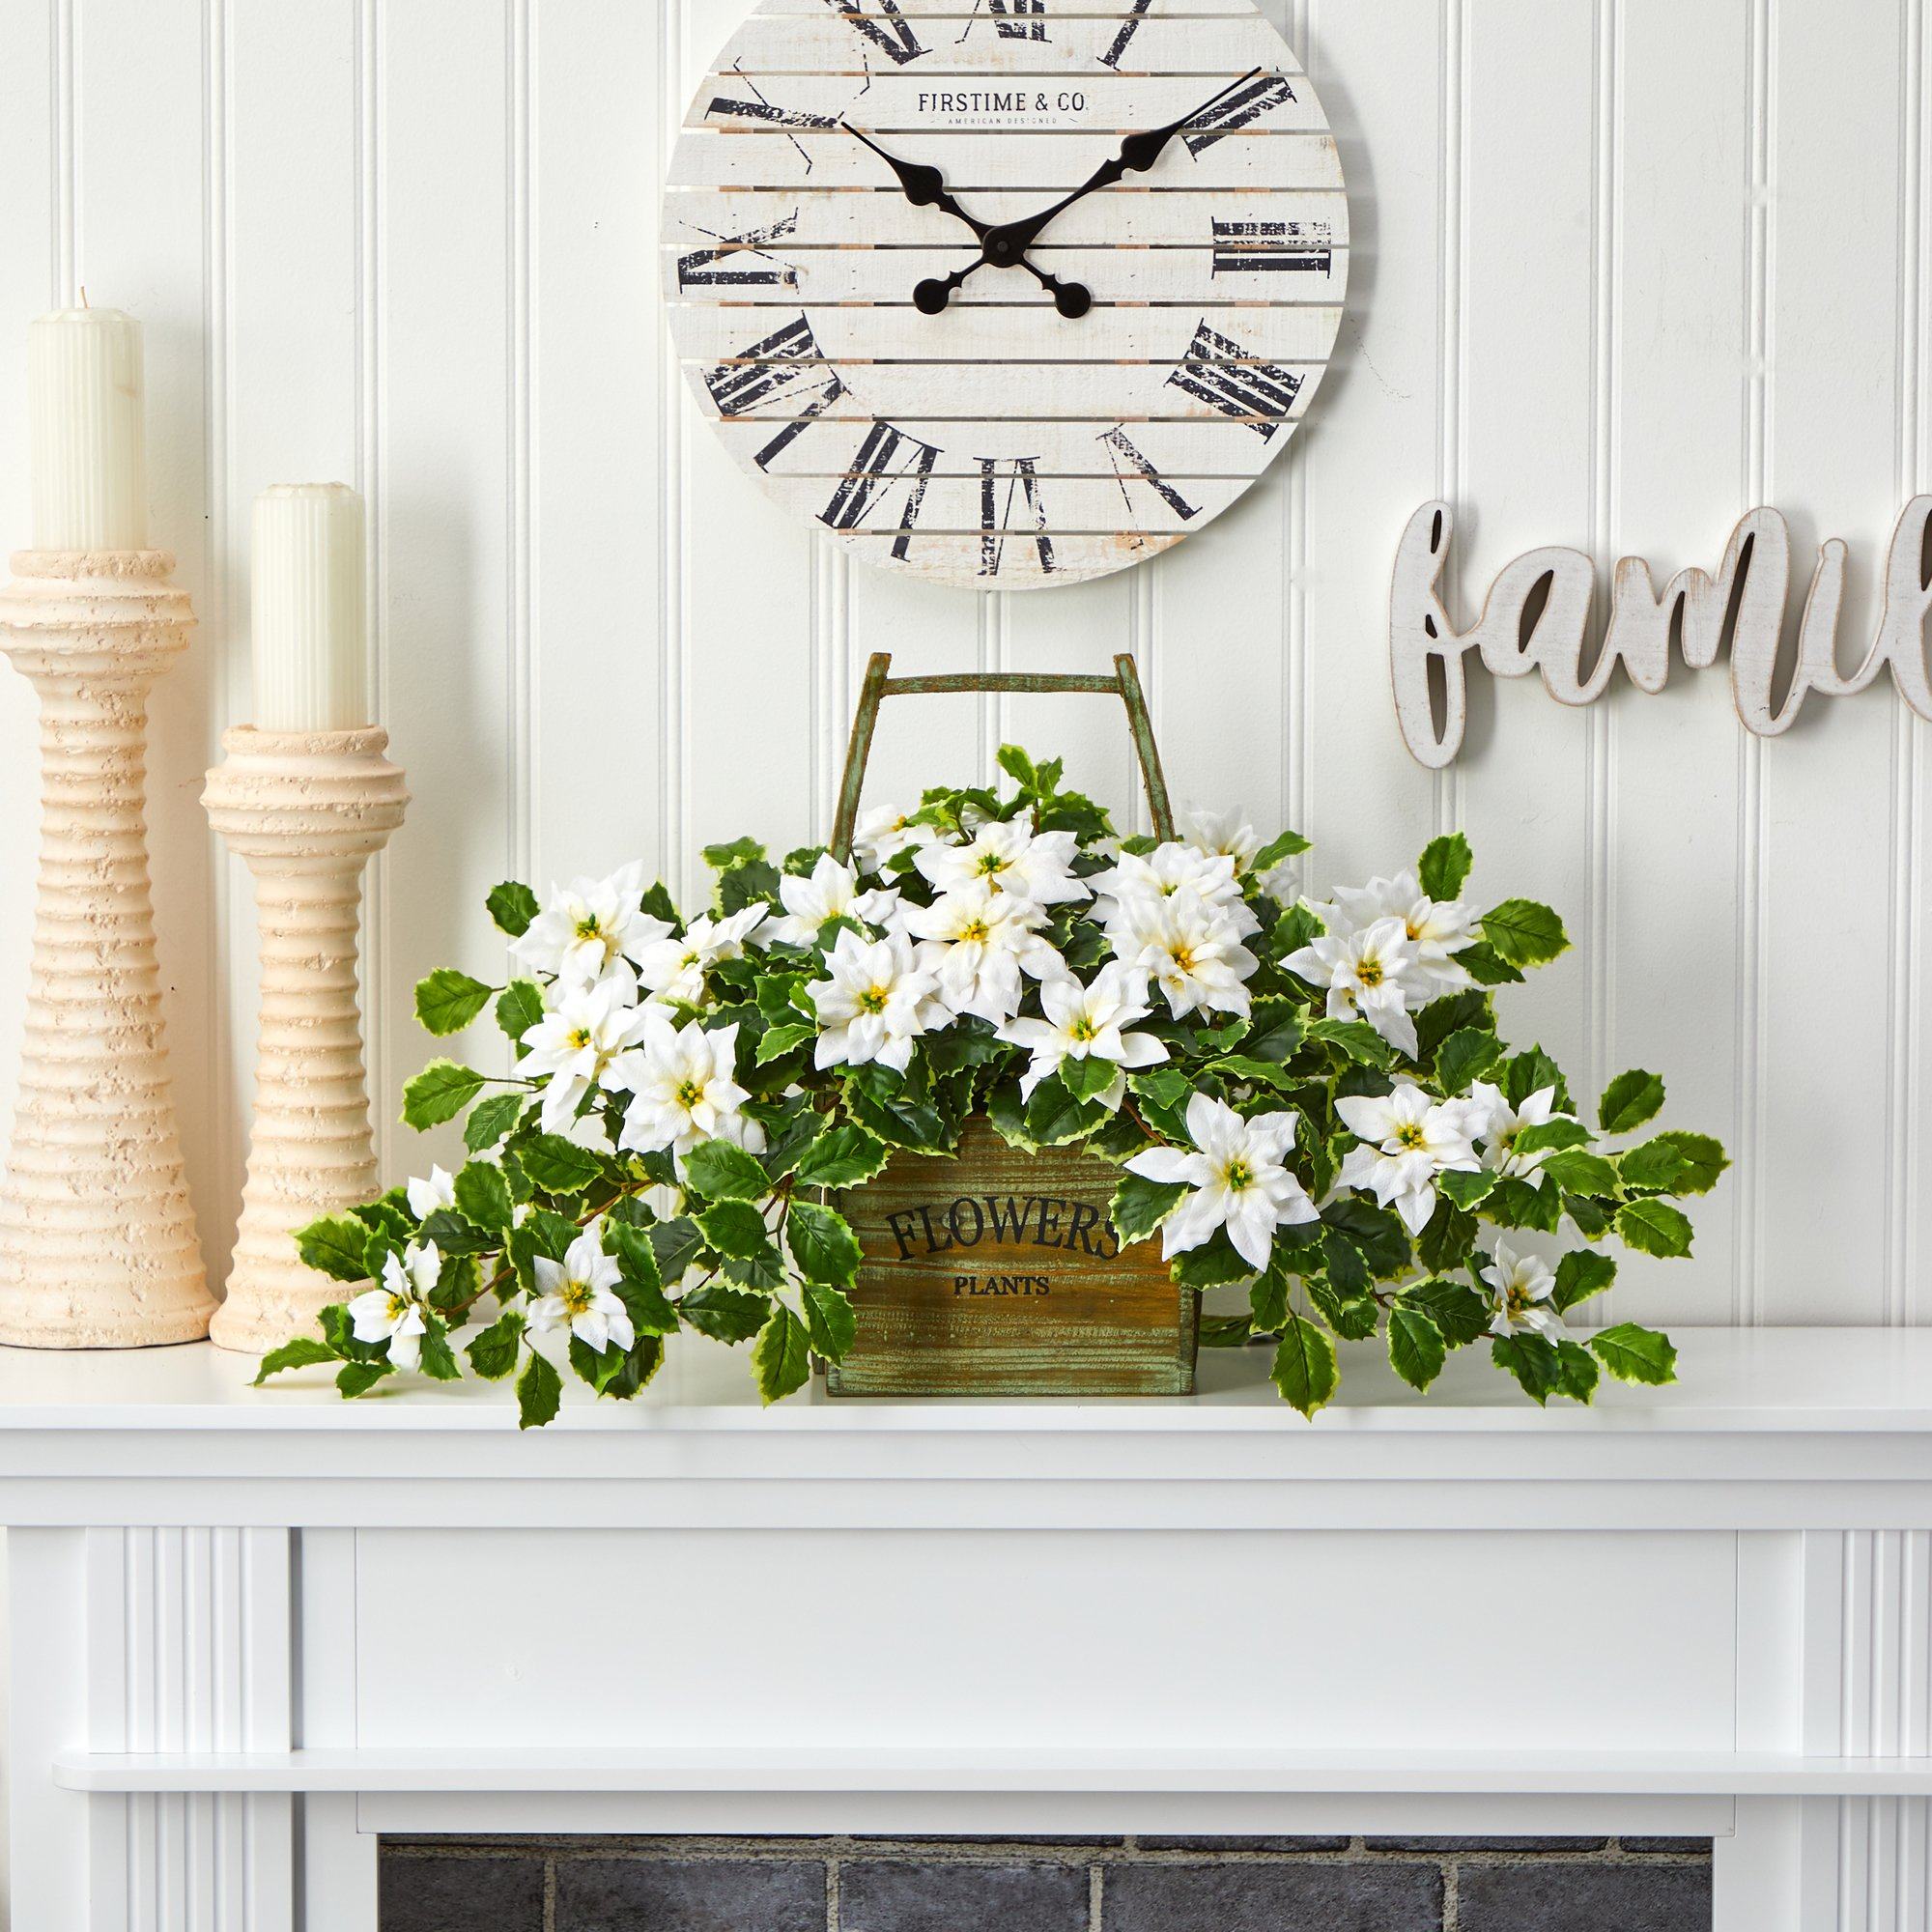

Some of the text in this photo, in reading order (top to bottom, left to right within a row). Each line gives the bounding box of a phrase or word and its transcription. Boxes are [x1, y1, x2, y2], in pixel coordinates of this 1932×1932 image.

[918, 93, 1027, 112] FIRSTIME
[1035, 93, 1049, 111] &
[953, 1275, 1050, 1295] PLANTS
